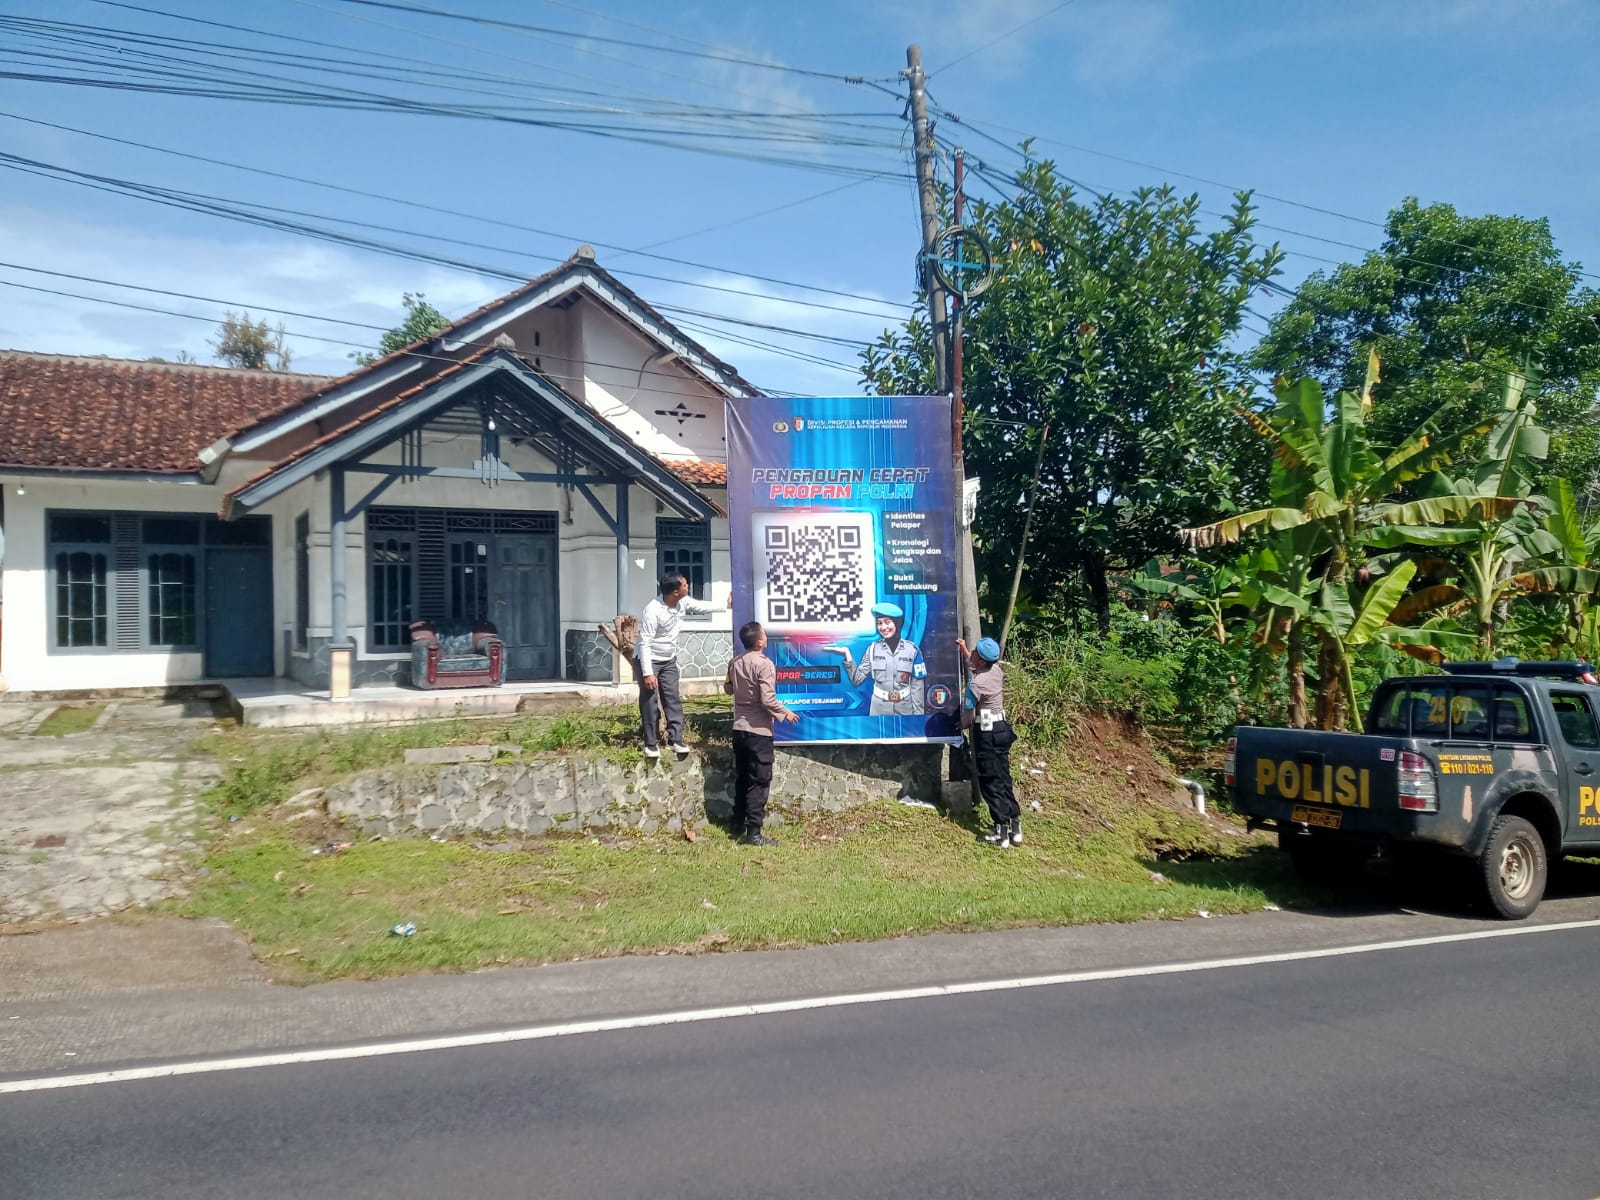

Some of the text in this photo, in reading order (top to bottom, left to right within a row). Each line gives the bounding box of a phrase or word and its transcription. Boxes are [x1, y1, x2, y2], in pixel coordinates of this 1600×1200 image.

[752, 467, 930, 483] PENGADUAN CEPAT
[769, 484, 914, 499] PROPAM POLRI
[890, 512, 926, 520] Identitas
[891, 522, 921, 530] Pelapor
[892, 539, 930, 547] Kronologi
[892, 548, 925, 556] Lengkap
[776, 671, 837, 679] APOR-BERES!
[1468, 763, 1494, 774] 021-110
[1256, 758, 1370, 808] POLISI
